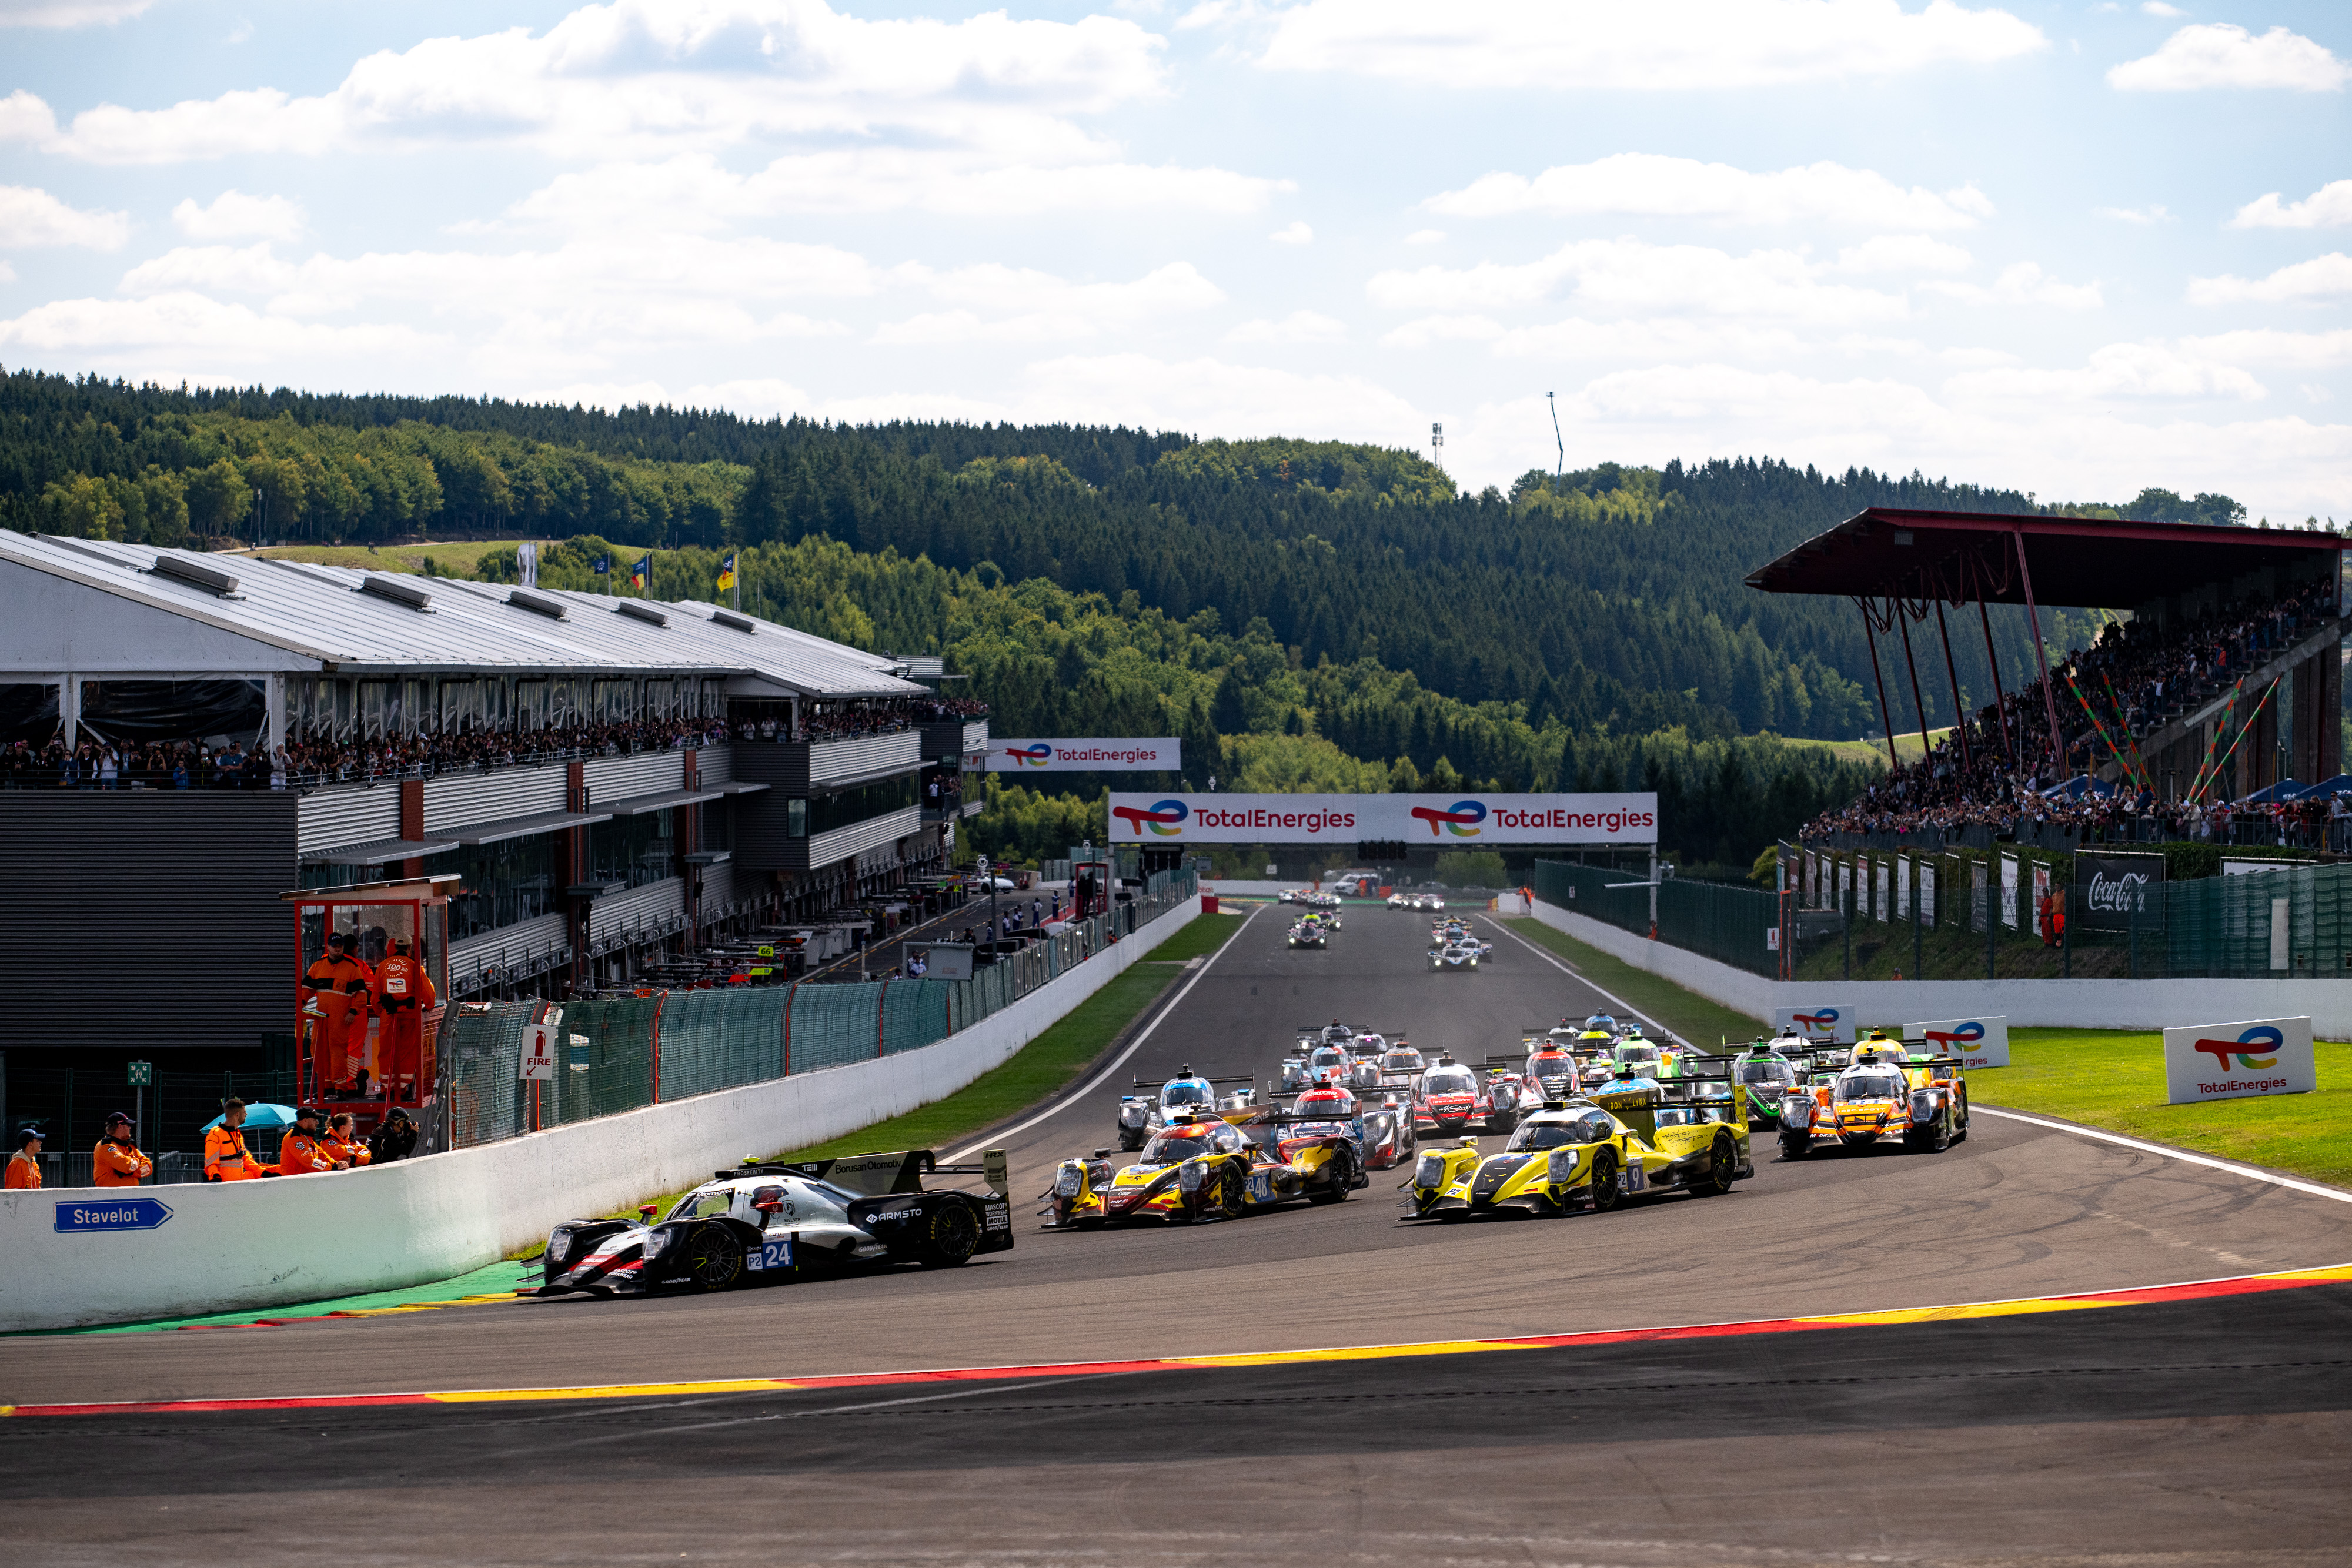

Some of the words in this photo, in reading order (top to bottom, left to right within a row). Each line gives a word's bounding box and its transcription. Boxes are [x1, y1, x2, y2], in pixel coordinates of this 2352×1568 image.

[1055, 748, 1157, 764] TotalEnergies
[1194, 808, 1355, 833] TotalEnergies
[1492, 808, 1653, 833] TotalEnergies
[527, 1058, 551, 1066] FIRE
[2197, 1077, 2287, 1094] TotalEnergies
[1608, 1101, 1622, 1111] IRON
[1632, 1097, 1646, 1106] LYNX
[835, 1164, 867, 1174] Borusan
[867, 1158, 901, 1171] Otomotiv
[1617, 1174, 1626, 1186] P2
[1632, 1167, 1639, 1189] 9
[697, 1188, 733, 1197] Otomotiv
[1244, 1178, 1253, 1191] P2
[1255, 1176, 1268, 1198] 48
[74, 1208, 138, 1224] Stavelot
[878, 1208, 923, 1221] ARMSTO
[749, 1256, 761, 1267] P2
[766, 1243, 790, 1267] 24
[858, 1243, 887, 1252] GOODYEAR
